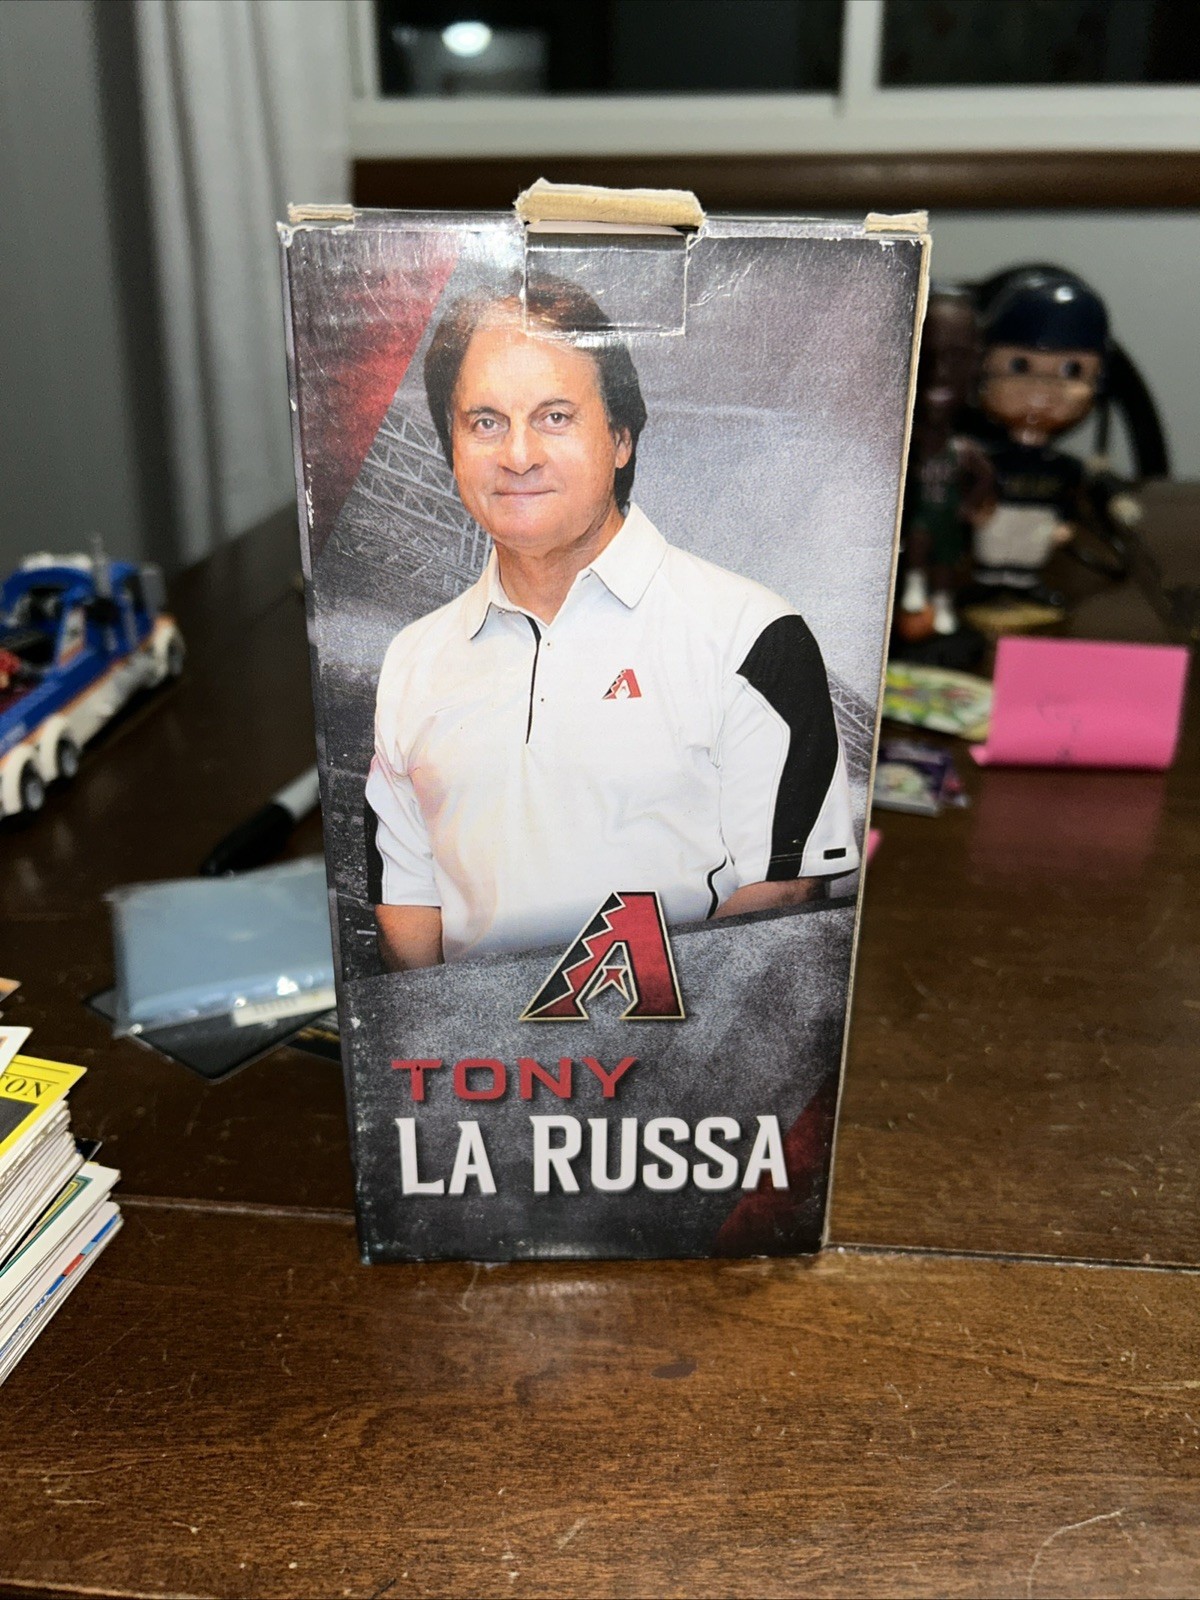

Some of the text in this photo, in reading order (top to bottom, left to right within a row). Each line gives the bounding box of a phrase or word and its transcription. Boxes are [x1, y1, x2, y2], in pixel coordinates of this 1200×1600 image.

[2, 1074, 52, 1099] ON
[391, 1056, 637, 1102] TONY
[395, 1114, 789, 1195] LA RUSSA
